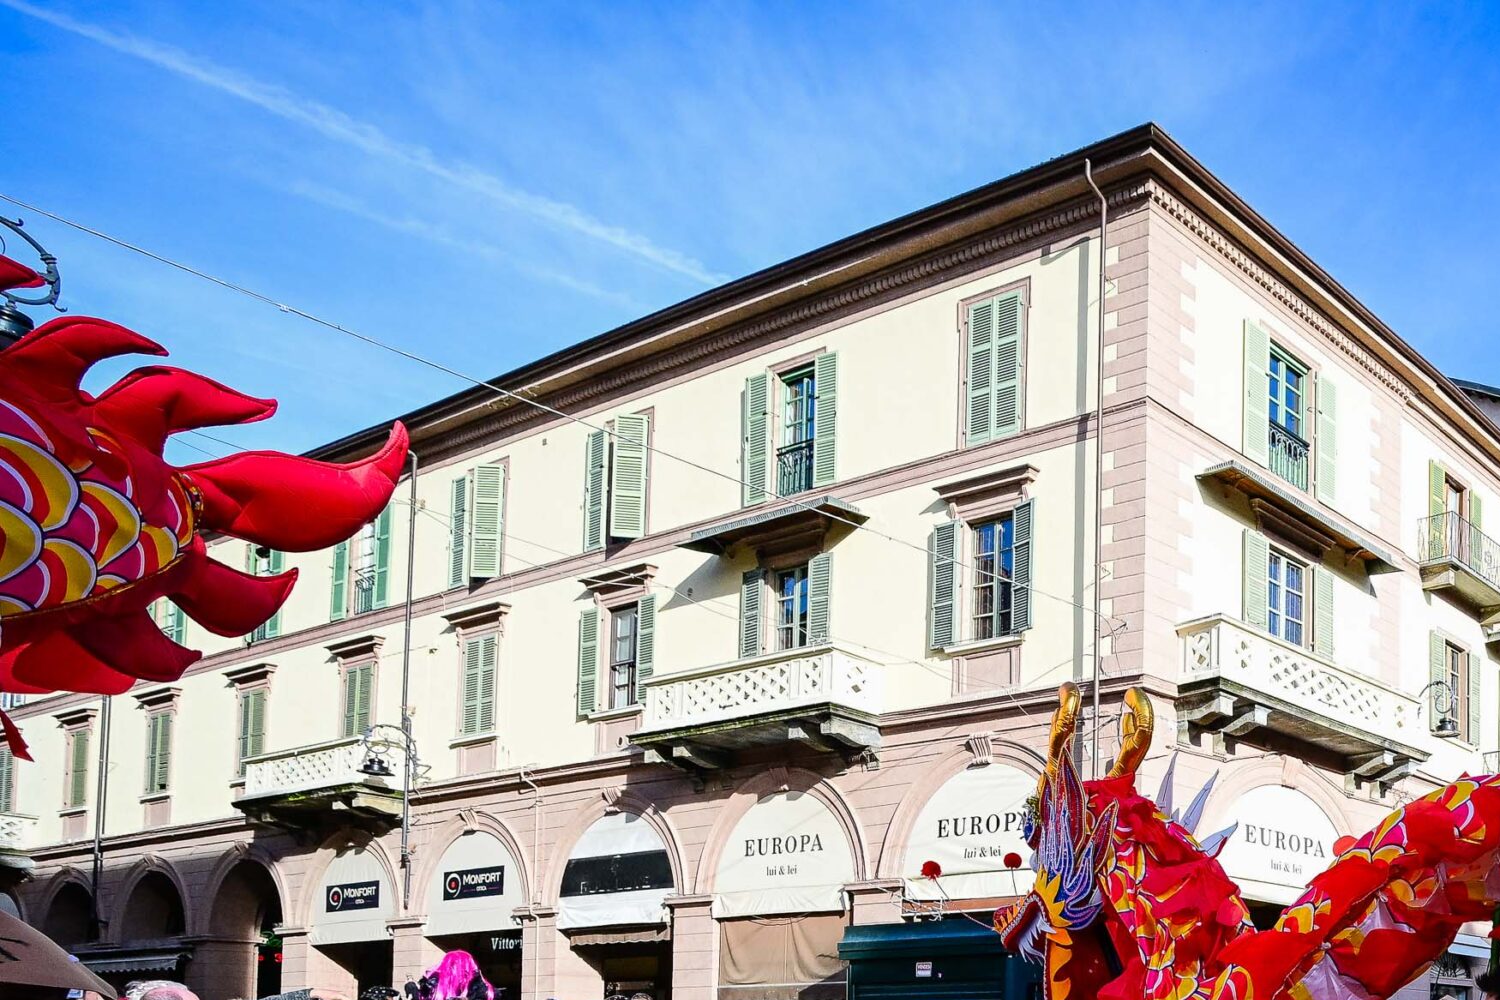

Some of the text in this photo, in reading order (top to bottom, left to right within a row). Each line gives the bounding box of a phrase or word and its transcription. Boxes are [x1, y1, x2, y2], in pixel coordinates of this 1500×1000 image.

[744, 833, 824, 857] EUROPA
[1244, 823, 1326, 859] EUROPA
[963, 845, 1001, 859] lui & lei
[766, 864, 798, 876] lui & lei
[1270, 859, 1302, 875] lui & lei
[462, 871, 501, 886] MONFORT
[343, 885, 377, 898] MONFORT
